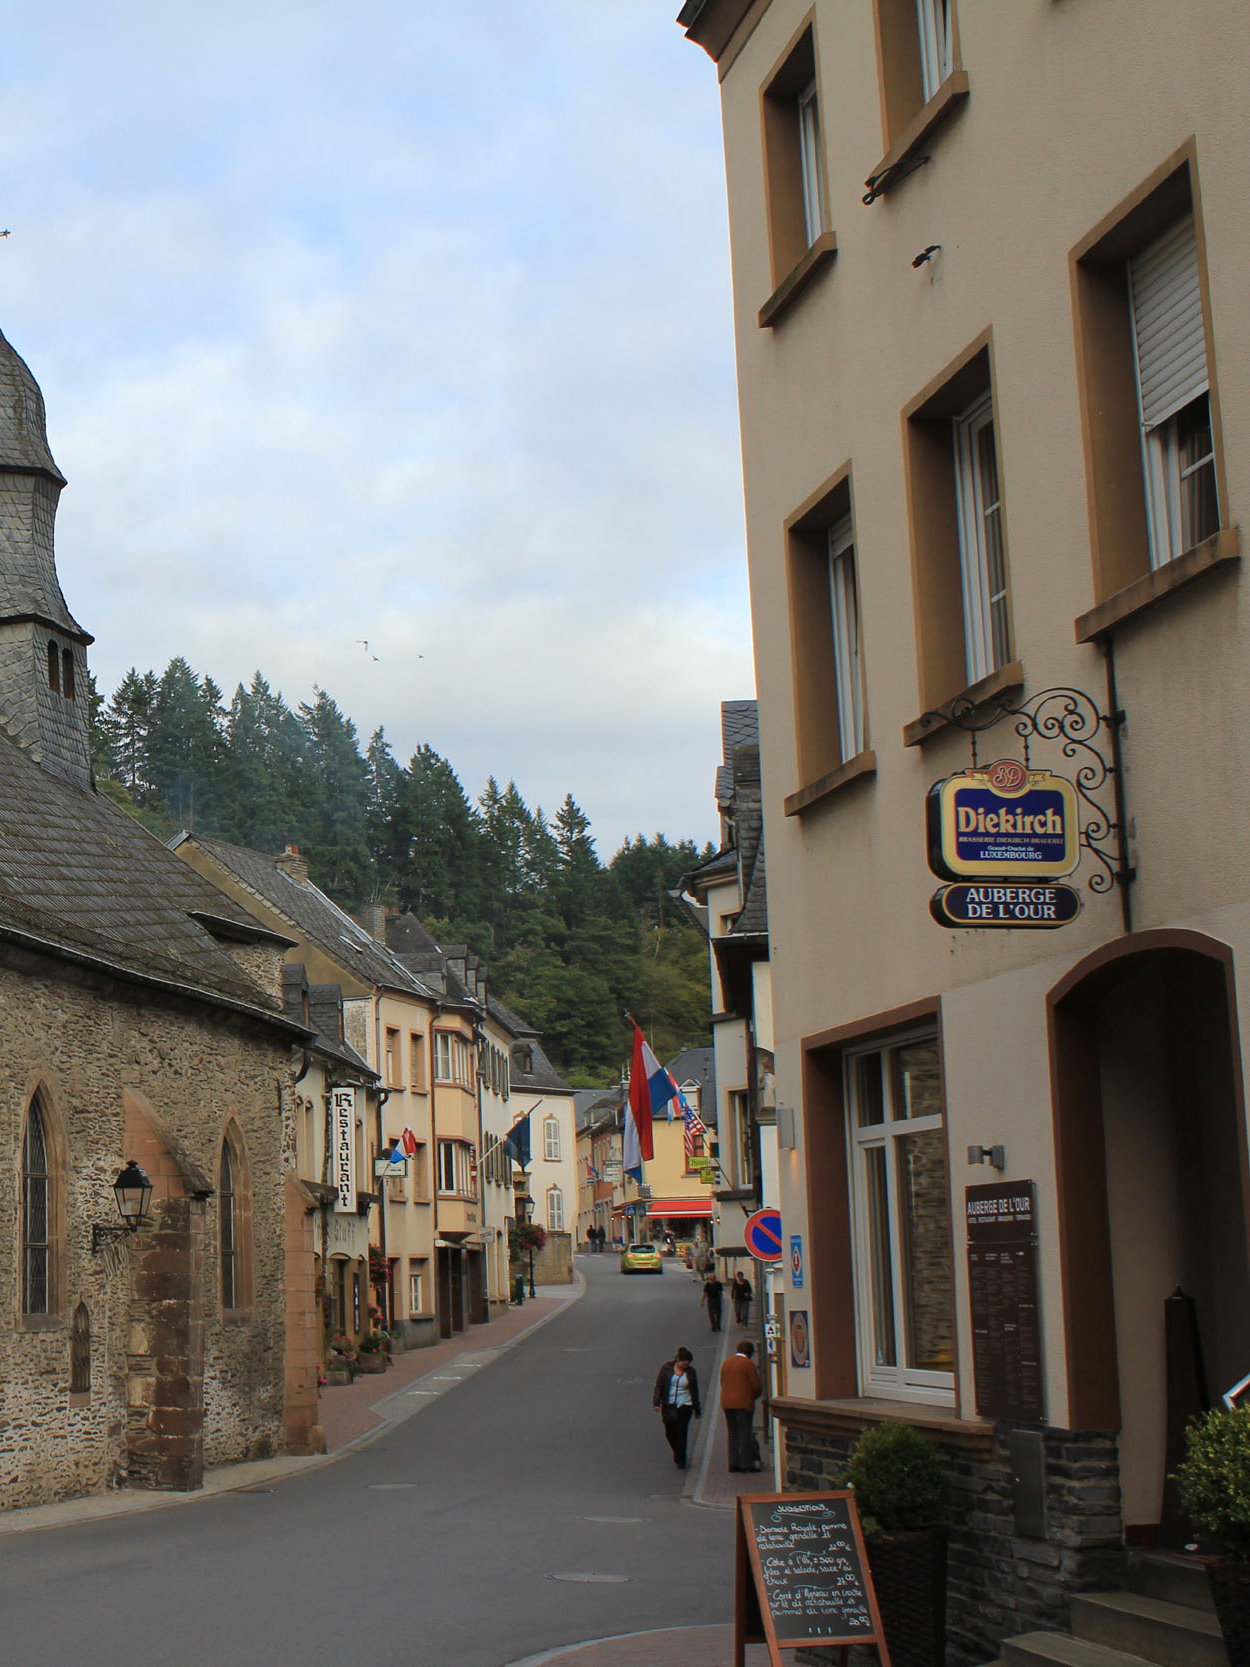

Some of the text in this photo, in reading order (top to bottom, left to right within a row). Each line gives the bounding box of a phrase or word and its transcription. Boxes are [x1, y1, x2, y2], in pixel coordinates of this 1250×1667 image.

[958, 807, 1063, 834] Diekirch
[980, 851, 1042, 860] LUXEMBOURG
[966, 888, 1057, 903] AUBERGE
[967, 904, 1057, 919] DE L'OUR
[334, 1093, 353, 1207] Restaurant
[967, 1196, 1030, 1215] AUBERGE DE L'OUR
